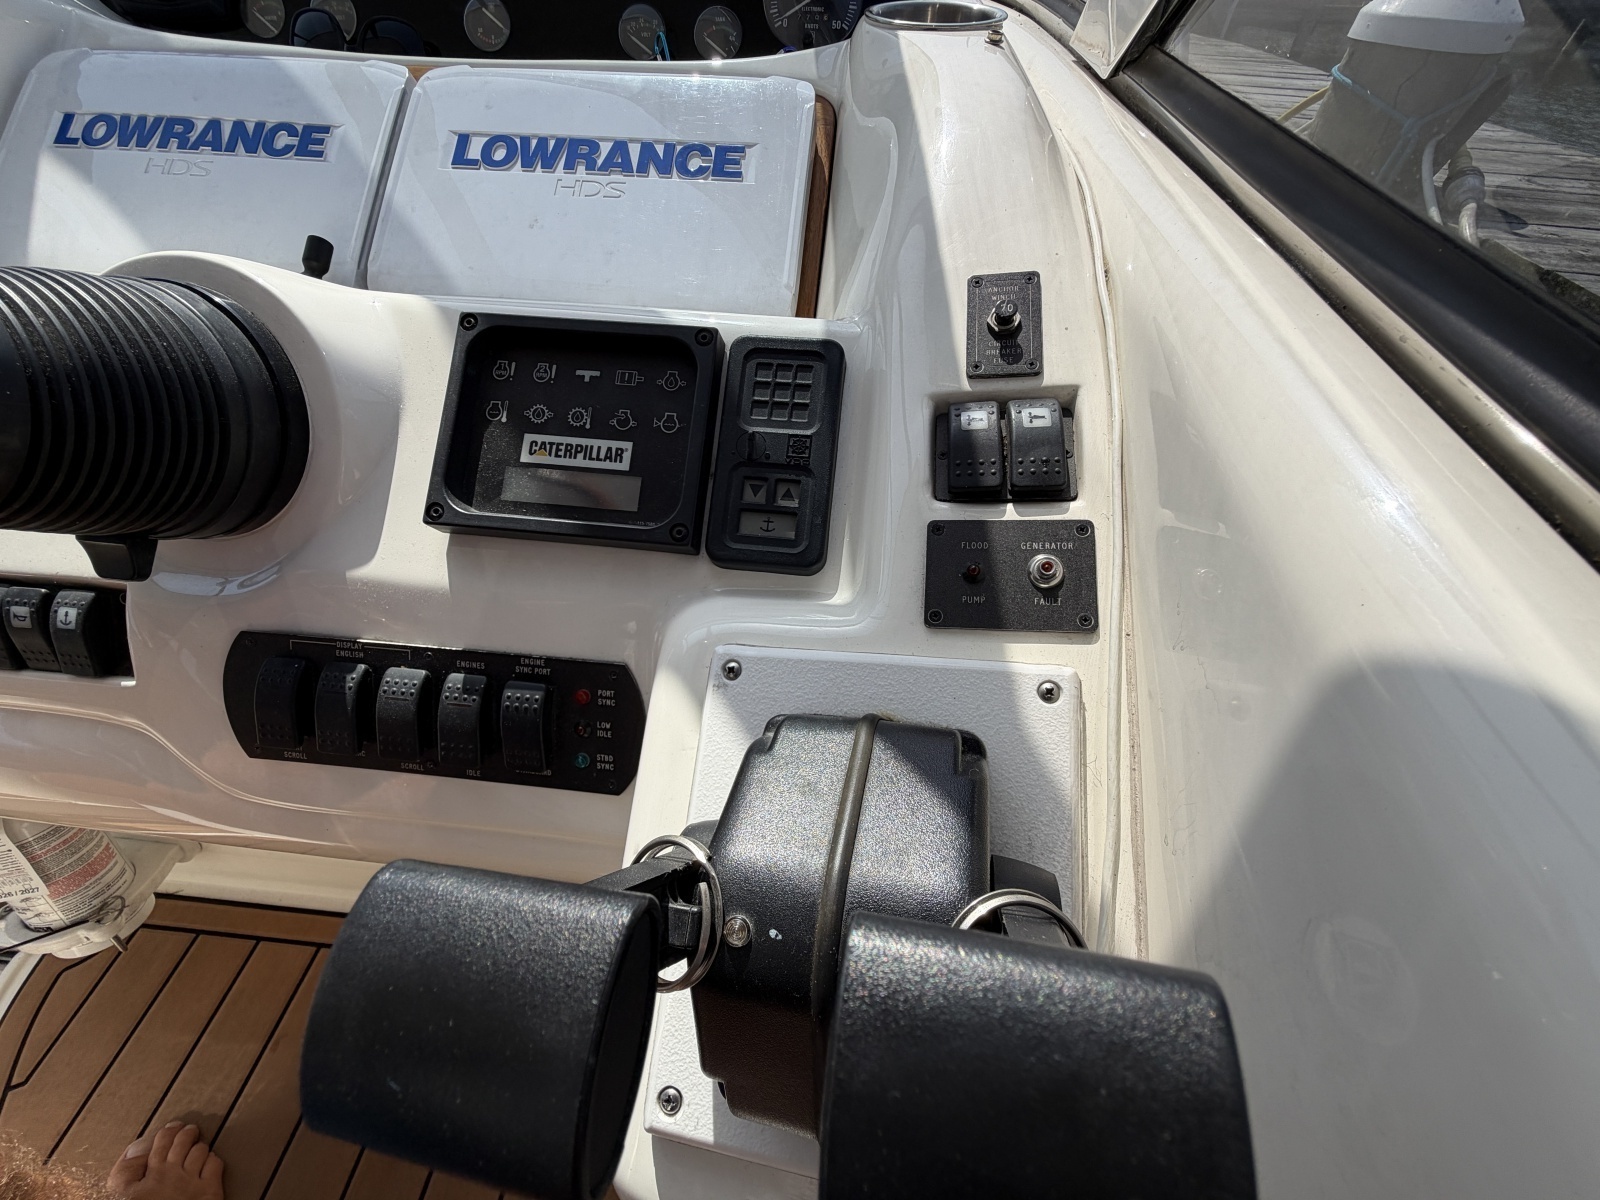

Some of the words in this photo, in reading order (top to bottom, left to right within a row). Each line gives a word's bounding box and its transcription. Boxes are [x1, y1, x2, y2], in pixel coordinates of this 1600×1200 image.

[831, 20, 842, 29] 50
[53, 112, 332, 161] LOWRANCE
[451, 132, 747, 182] LOWRANCE
[144, 157, 214, 177] HDS
[553, 178, 627, 199] HDS
[987, 285, 1019, 293] ANCHOR
[991, 293, 1017, 301] WINCH
[1000, 303, 1014, 312] 70
[528, 440, 627, 464] CATERPILLAR
[961, 541, 989, 549] FLOOD
[1020, 542, 1074, 550] GENERATOR
[962, 595, 986, 604] PUMP
[1034, 597, 1062, 606] FAULT
[336, 641, 363, 650] DISPLAY
[335, 650, 364, 659] ENGLISH
[456, 660, 485, 670] ENGINES
[520, 657, 545, 667] ENGINE
[515, 666, 533, 675] SYNC
[534, 667, 551, 676] PORT
[597, 689, 615, 698] PORT
[597, 698, 616, 707] SYNC
[596, 721, 611, 730] LOW
[596, 730, 612, 739] IDLE
[283, 751, 308, 760] SCROLL
[596, 754, 614, 763] STBD
[400, 762, 425, 771] SCROLL
[596, 762, 615, 771] SYNC
[466, 769, 481, 777] IDLE
[19, 886, 40, 896] 2027
